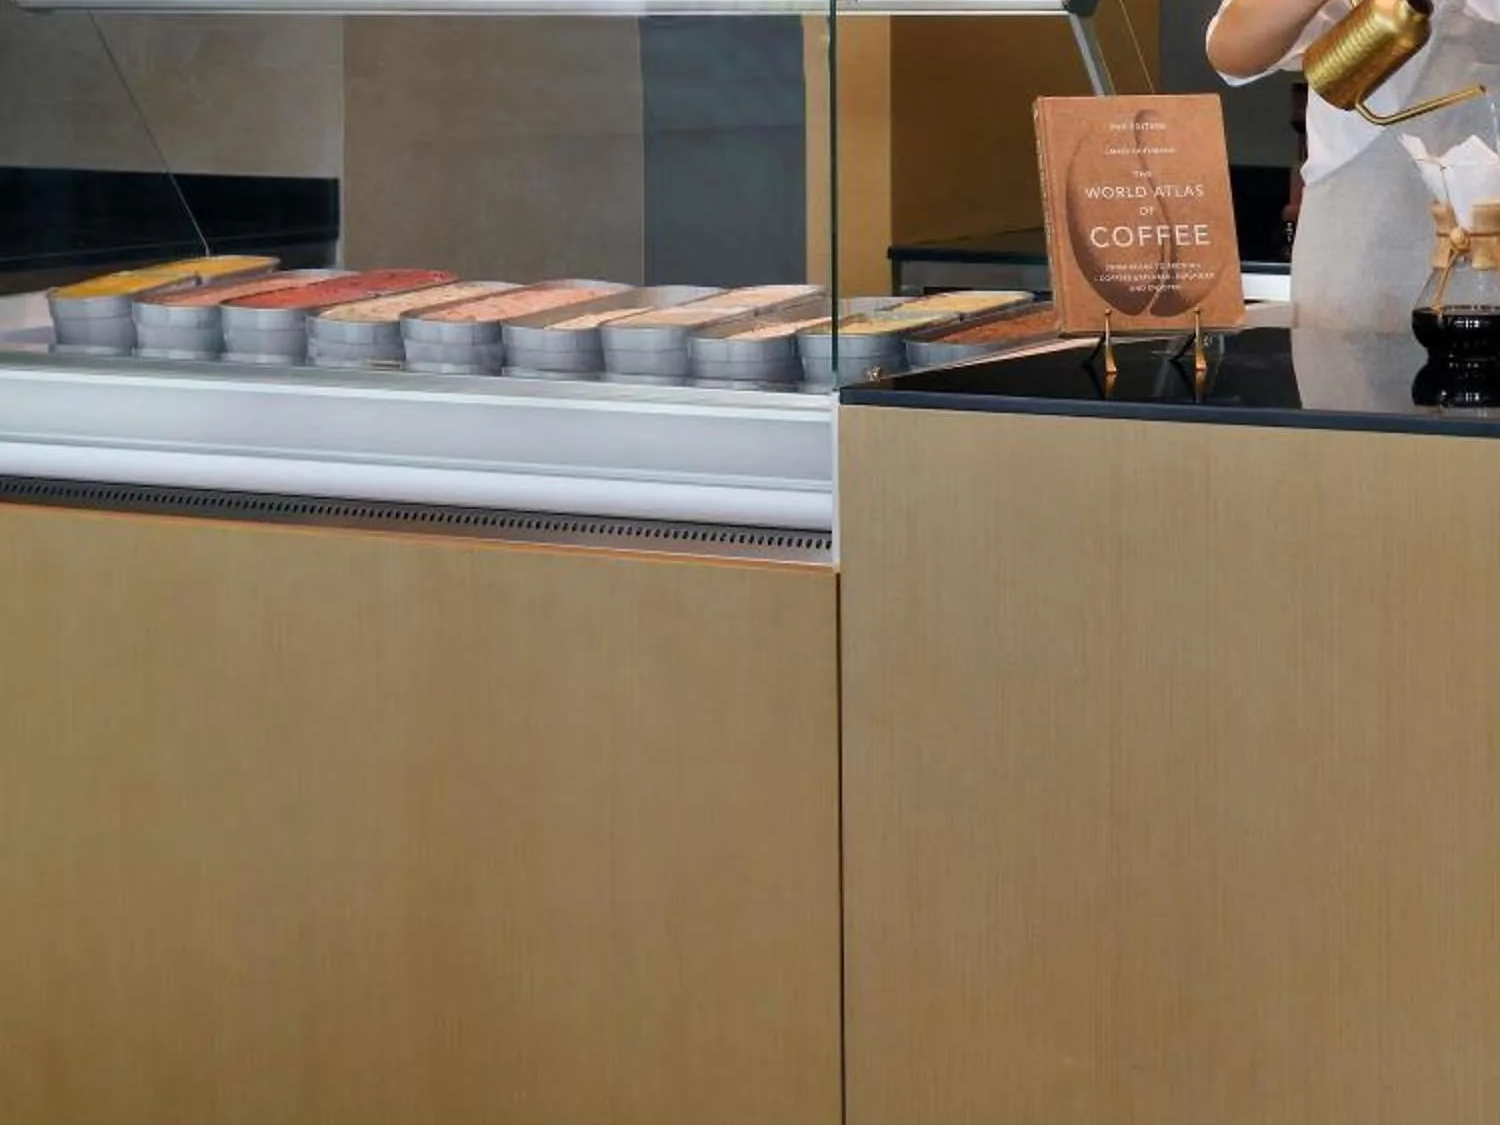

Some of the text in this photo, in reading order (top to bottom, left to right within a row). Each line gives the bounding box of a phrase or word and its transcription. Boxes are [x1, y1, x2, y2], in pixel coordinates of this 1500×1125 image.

[1084, 183, 1205, 199] WORLD ATLAS
[1139, 206, 1154, 216] OF
[1090, 224, 1211, 248] COFFEE
